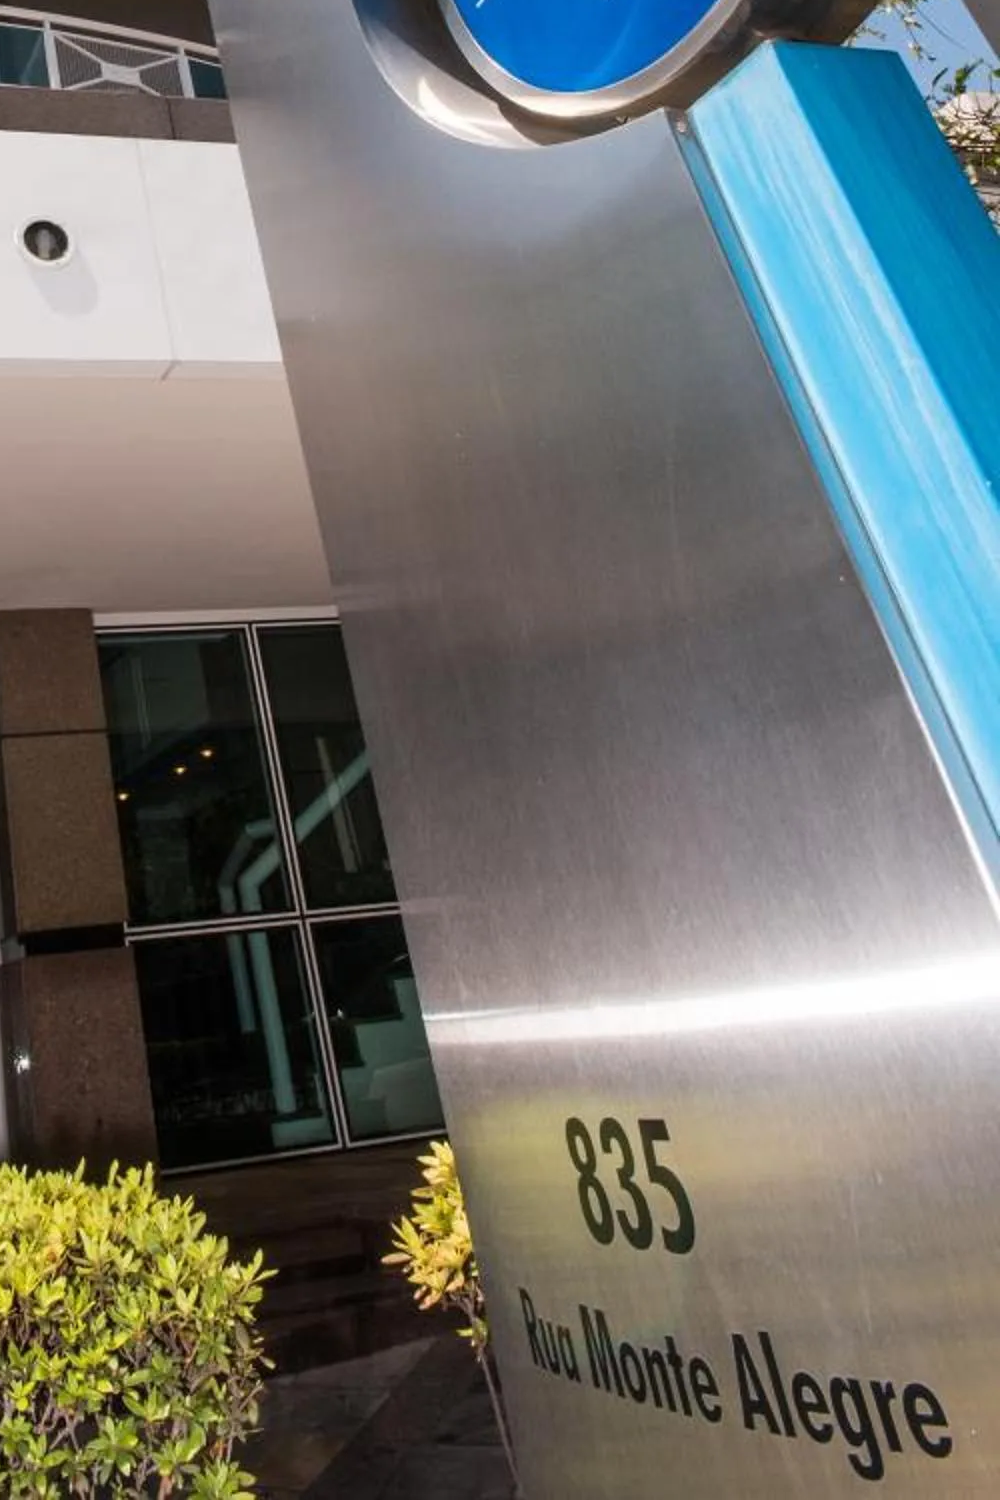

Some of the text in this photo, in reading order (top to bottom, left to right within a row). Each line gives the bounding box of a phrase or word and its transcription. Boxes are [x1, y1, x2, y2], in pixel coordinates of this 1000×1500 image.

[565, 1116, 696, 1254] 835
[517, 1287, 953, 1481] Rua Monte Alegre
